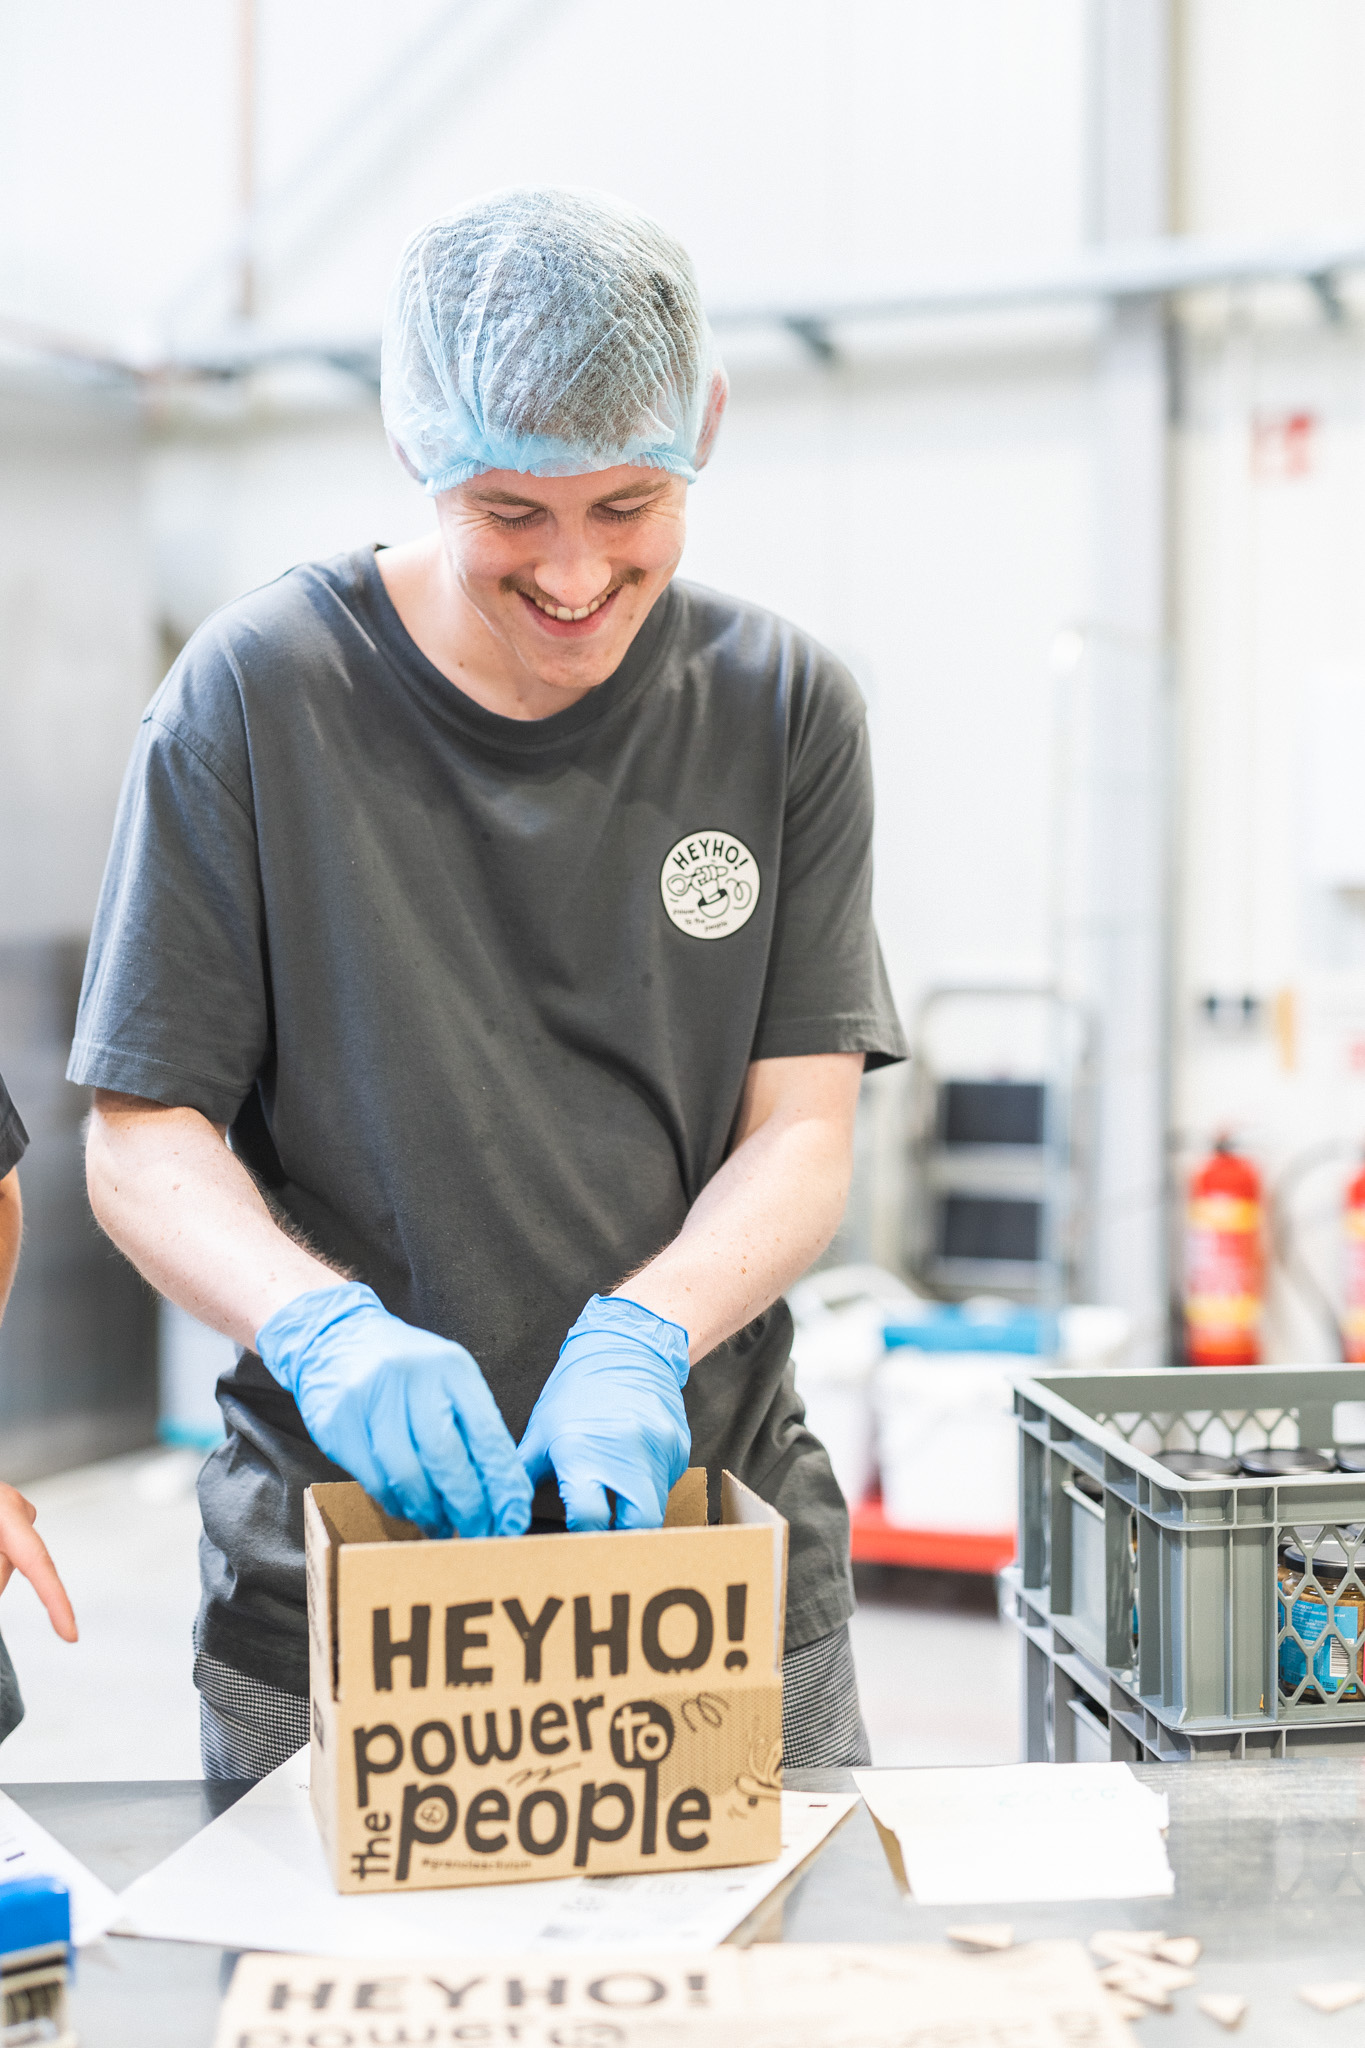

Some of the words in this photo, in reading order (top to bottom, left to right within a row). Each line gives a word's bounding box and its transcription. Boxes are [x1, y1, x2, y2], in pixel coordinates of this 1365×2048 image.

[673, 839, 748, 870] HEYHO!
[371, 1582, 749, 1692] HEYHO!
[353, 1694, 605, 1808] power
[615, 1706, 668, 1762] to
[351, 1810, 392, 1881] the
[394, 1768, 711, 1880] people
[268, 1971, 709, 2012] HEYHO!
